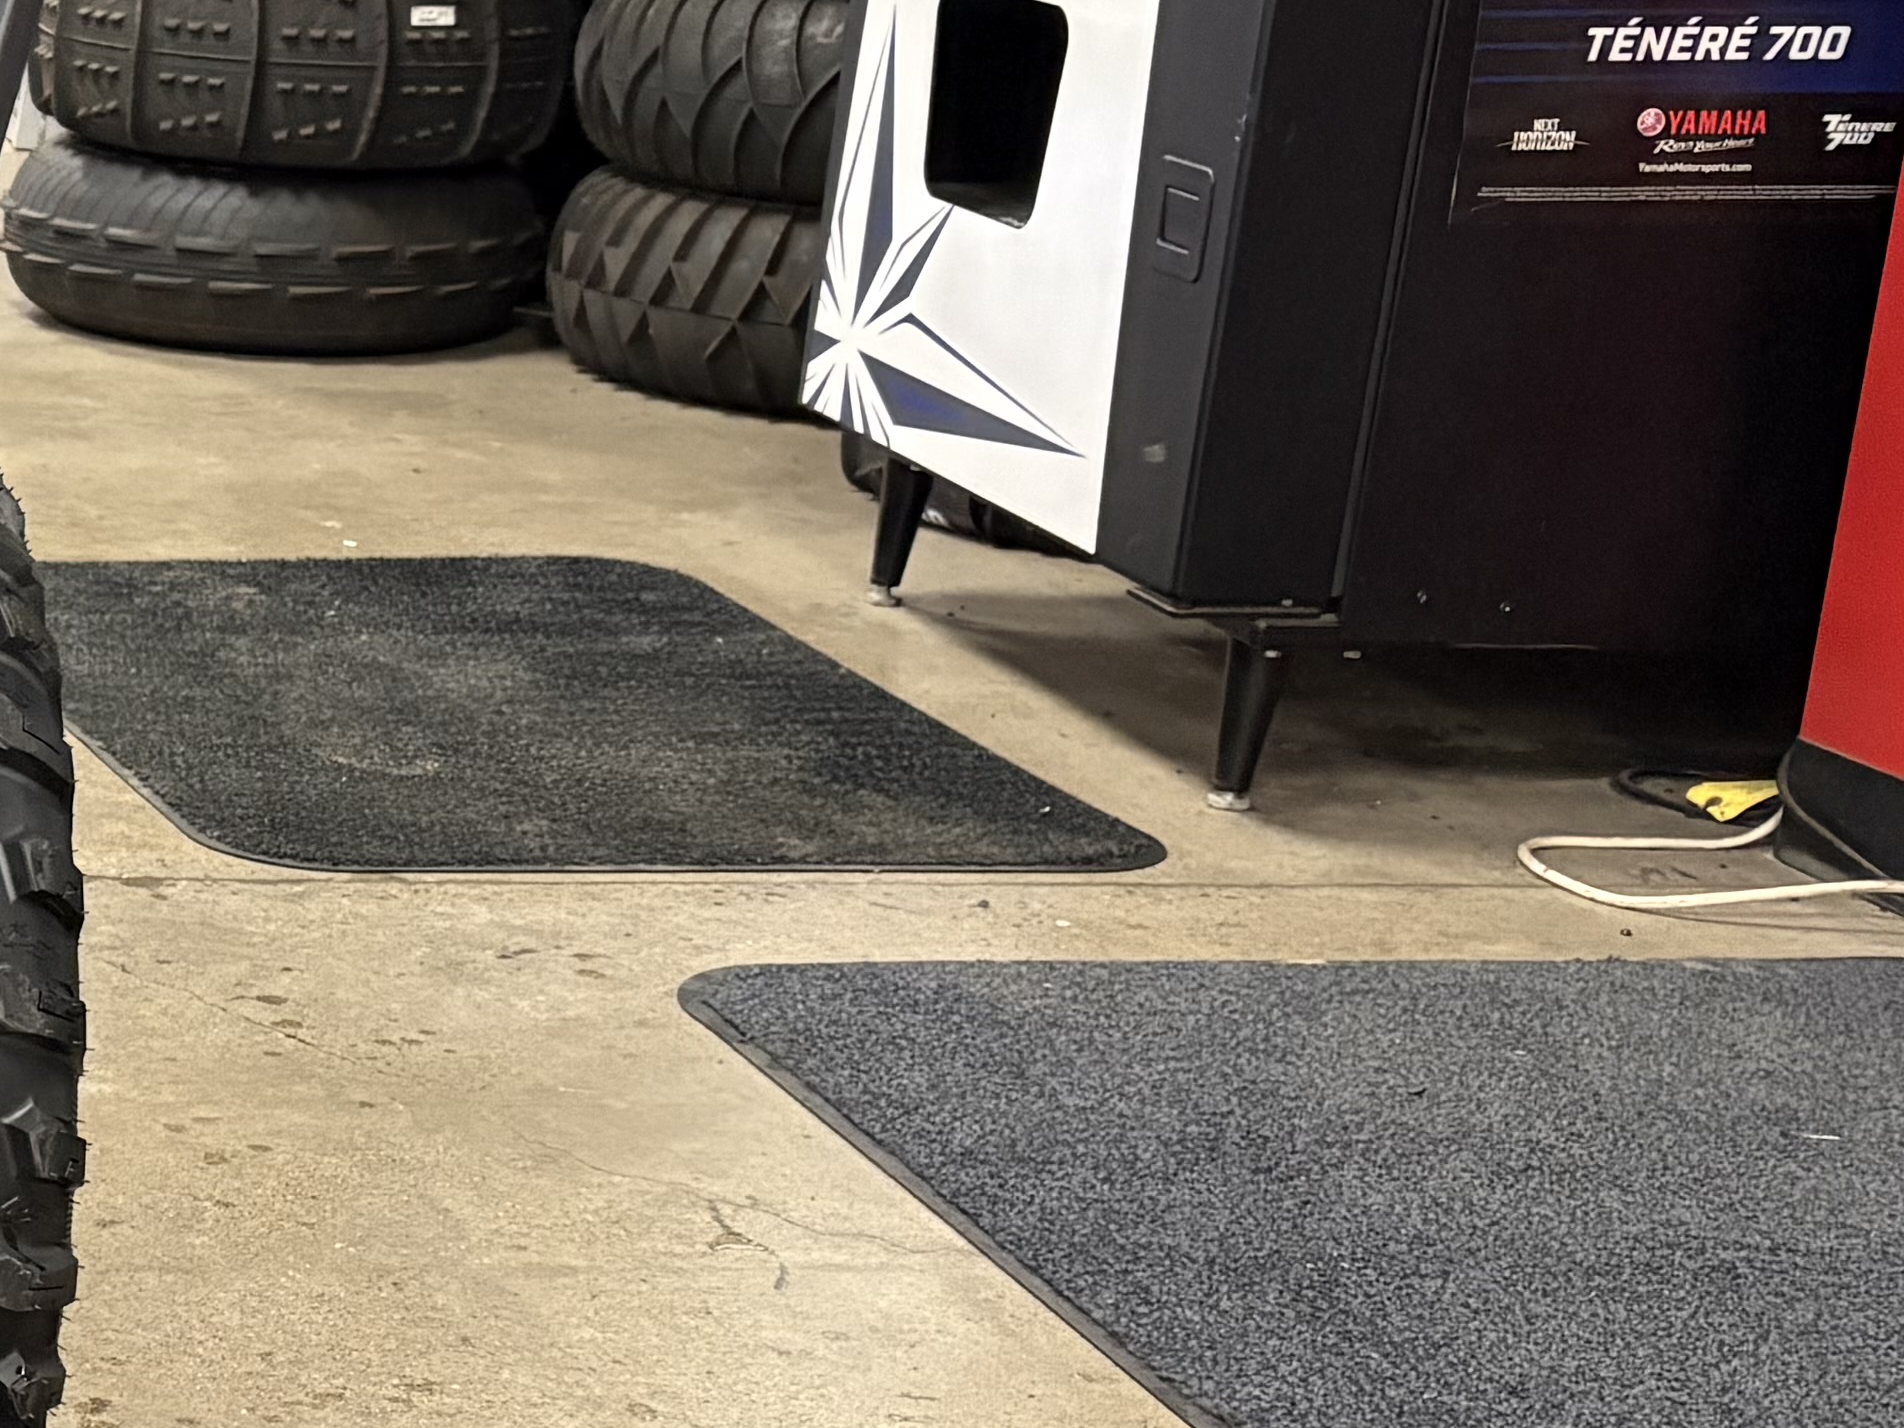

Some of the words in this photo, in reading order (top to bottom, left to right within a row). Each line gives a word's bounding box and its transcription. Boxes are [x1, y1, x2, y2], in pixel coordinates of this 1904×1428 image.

[1587, 16, 1760, 62] TÉNÉRÉ
[1763, 25, 1852, 60] 700
[1534, 118, 1560, 131] NEXT
[1669, 109, 1766, 135] YAMAHA
[1510, 130, 1576, 151] HORIZON
[1824, 132, 1875, 151] 700
[1639, 162, 1752, 174] YamahaMotorsports.com
